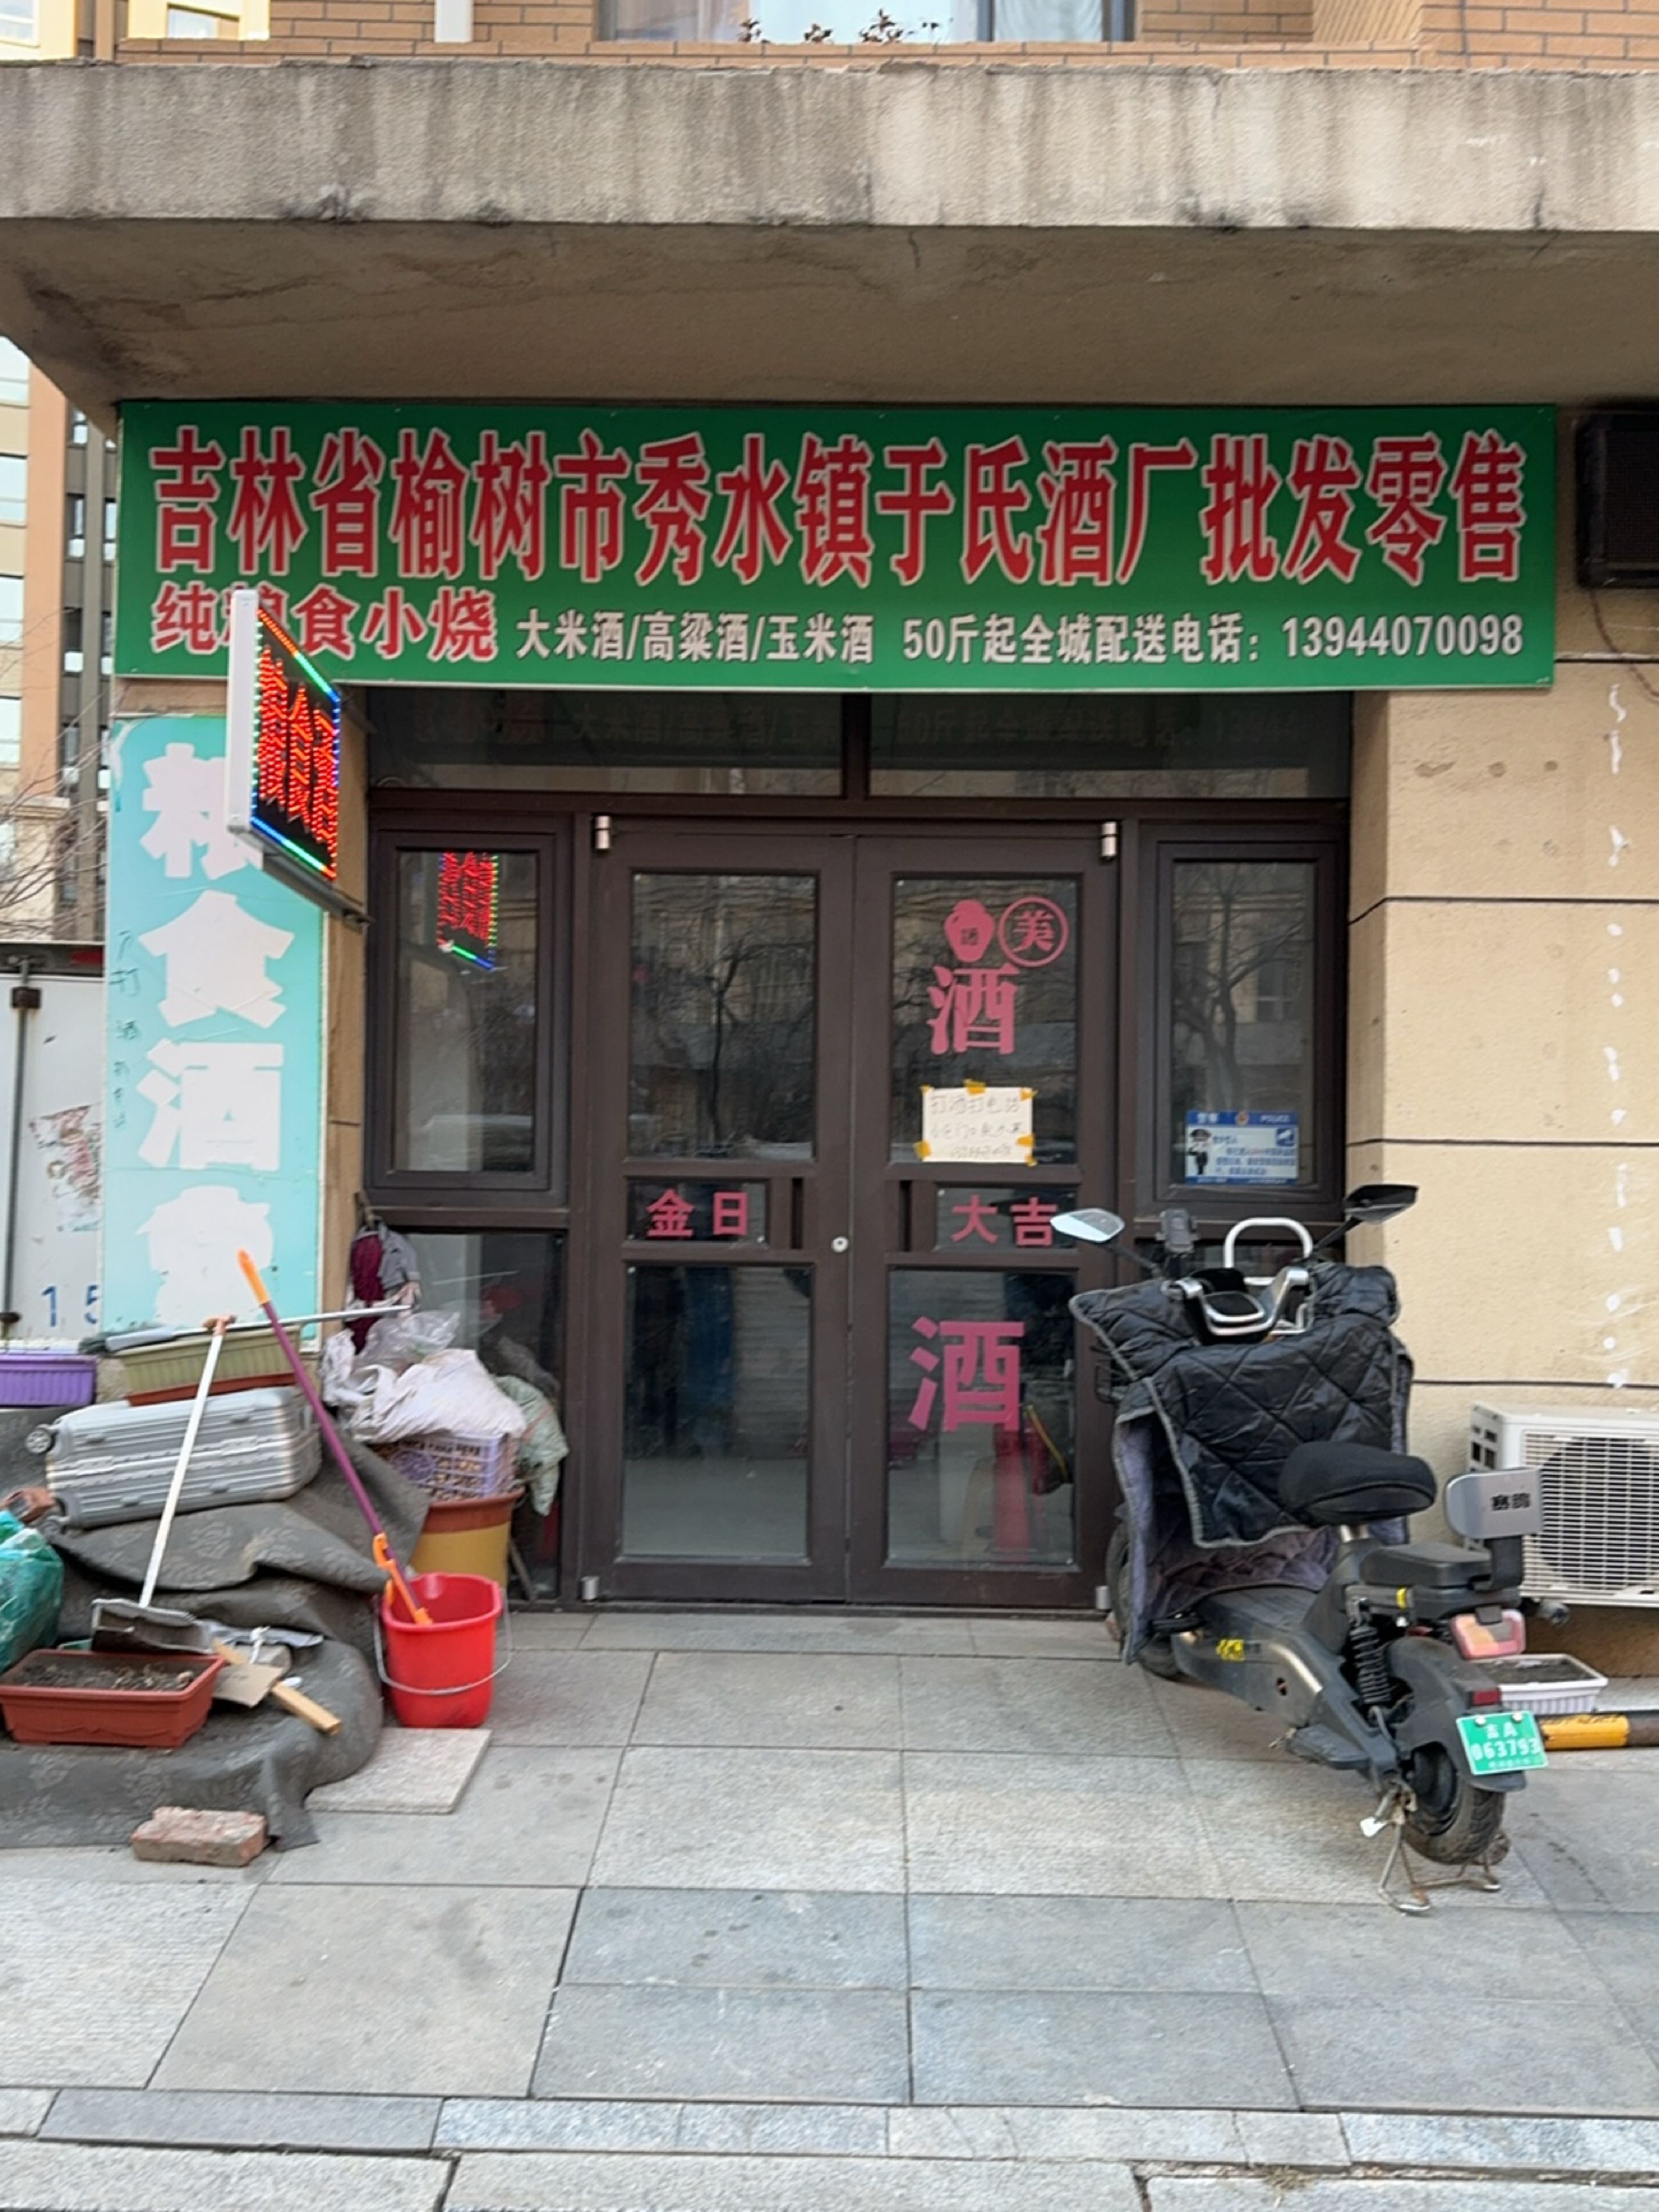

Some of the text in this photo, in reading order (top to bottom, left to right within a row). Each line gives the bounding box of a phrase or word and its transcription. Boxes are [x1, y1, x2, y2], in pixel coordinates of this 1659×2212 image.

[148, 426, 1527, 588] 吉林省榆树市秀水镇于氏酒厂批发零售
[515, 608, 874, 663] 大米酒/高粱酒/玉米酒
[1282, 614, 1523, 659] 13944070098
[1013, 910, 1055, 952] 美
[927, 963, 1020, 1055] 酒
[646, 1189, 748, 1238] 金日
[951, 1194, 1059, 1247] 大吉
[908, 1316, 1025, 1432] 酒
